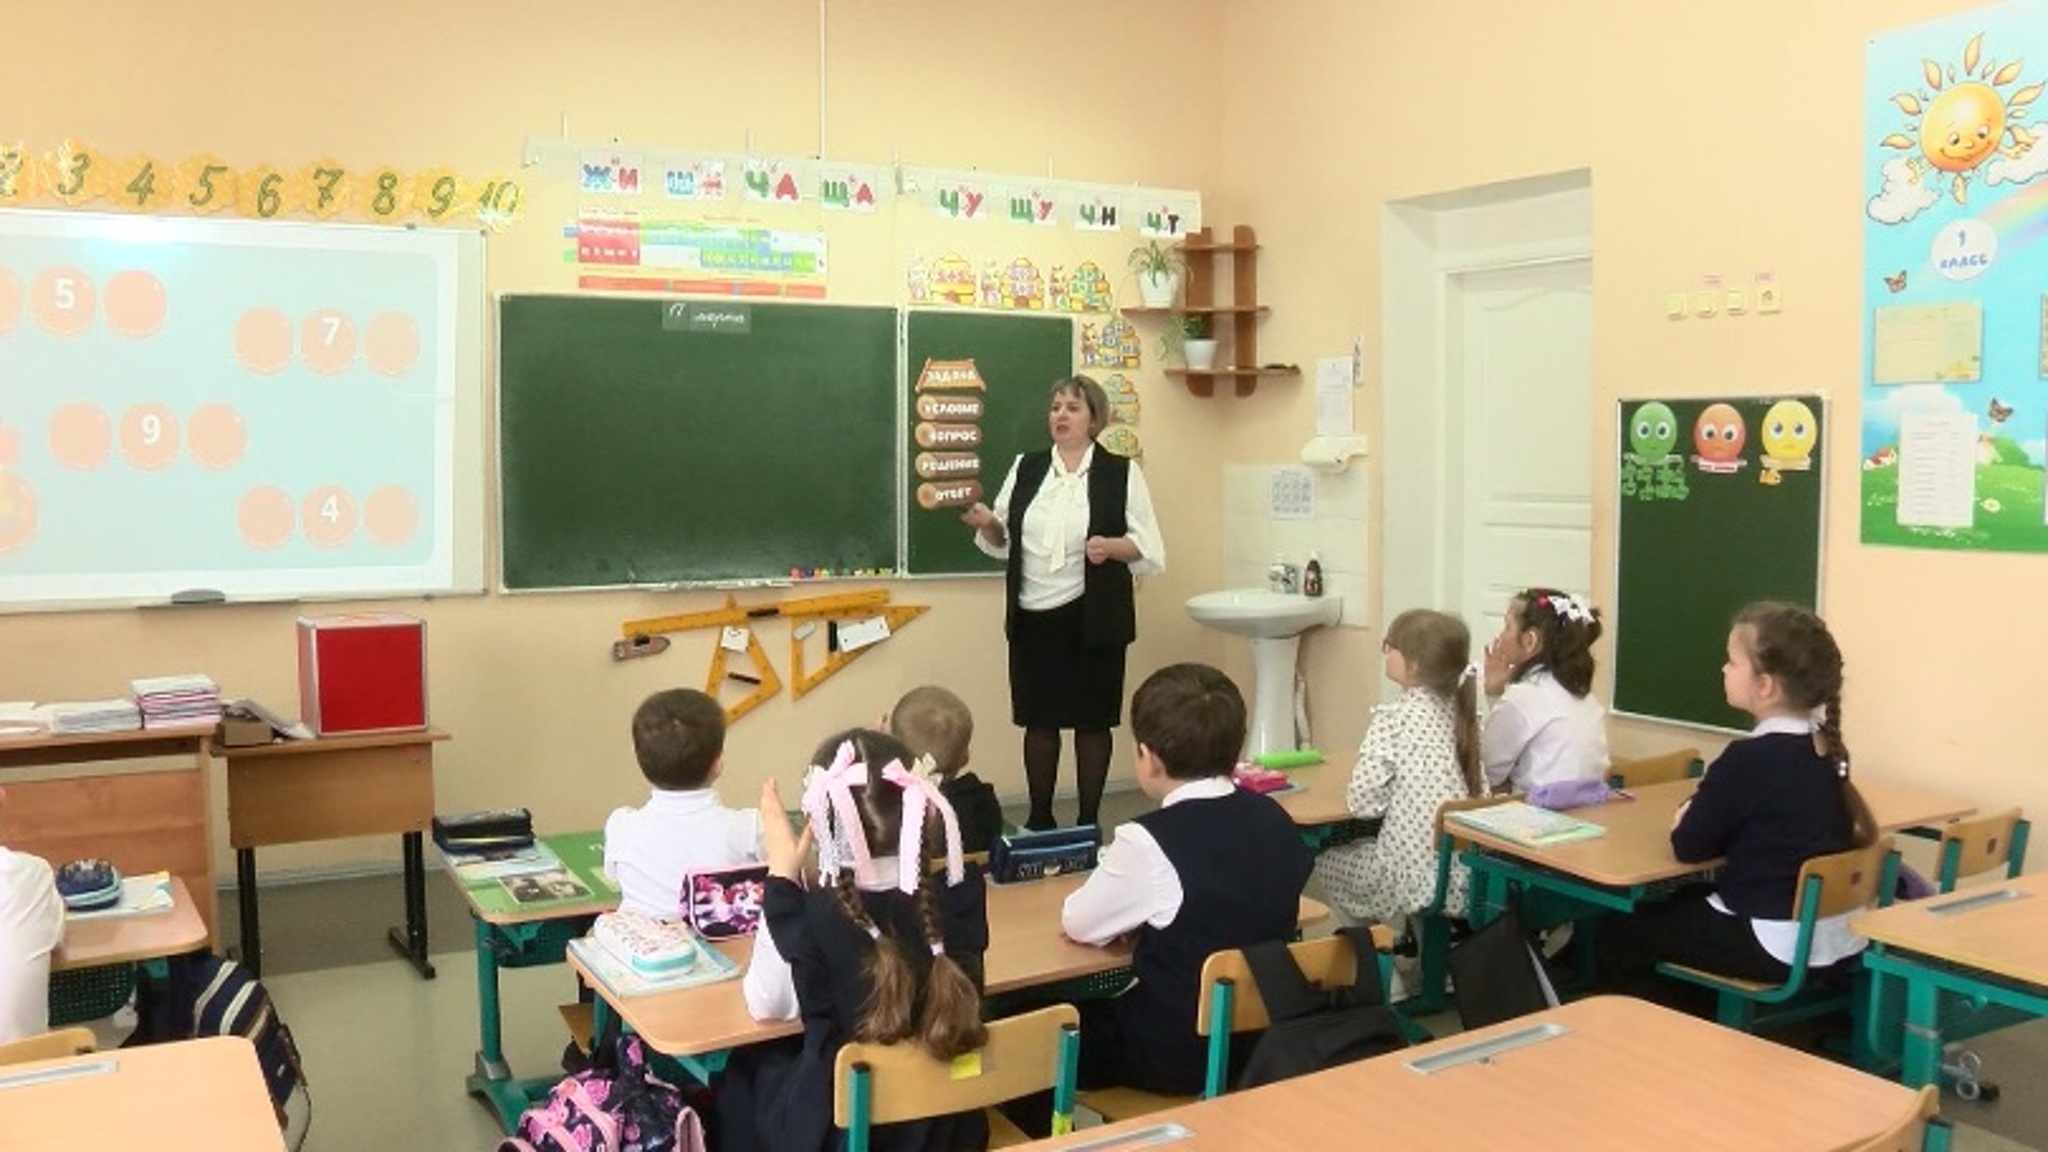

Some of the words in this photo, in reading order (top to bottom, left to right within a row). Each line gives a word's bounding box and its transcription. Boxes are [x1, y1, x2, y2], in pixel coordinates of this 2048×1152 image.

[58, 153, 91, 195] 3
[126, 162, 155, 205] 4
[189, 165, 228, 206] 5
[257, 174, 284, 217] 6
[314, 168, 344, 208] 7
[372, 172, 398, 215] 8
[427, 176, 456, 217] 9
[478, 181, 519, 215] 10
[55, 278, 75, 309] 5
[321, 318, 341, 345] 7
[141, 415, 161, 444] 9
[935, 486, 972, 501] ОТВЕТ
[320, 495, 340, 522] 4
